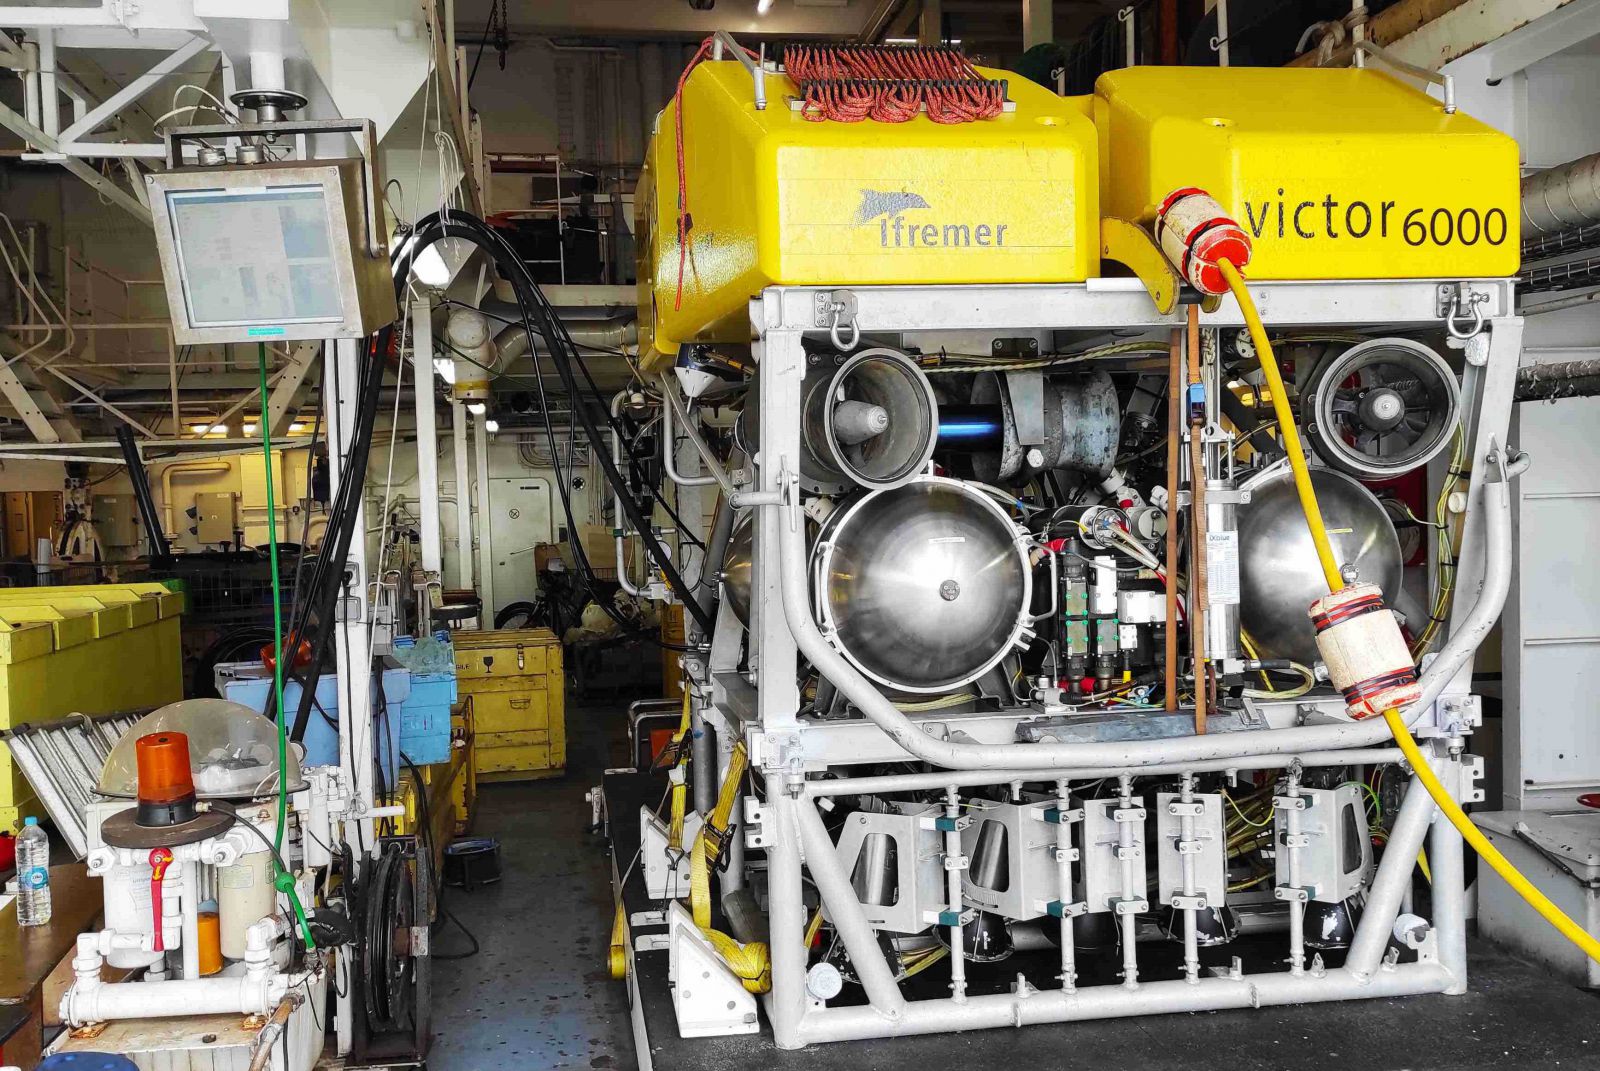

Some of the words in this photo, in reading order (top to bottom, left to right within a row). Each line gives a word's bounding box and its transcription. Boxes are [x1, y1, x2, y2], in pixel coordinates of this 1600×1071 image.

[881, 217, 1007, 246] Ifremer
[1245, 188, 1396, 239] victor
[1403, 207, 1509, 246] 6000
